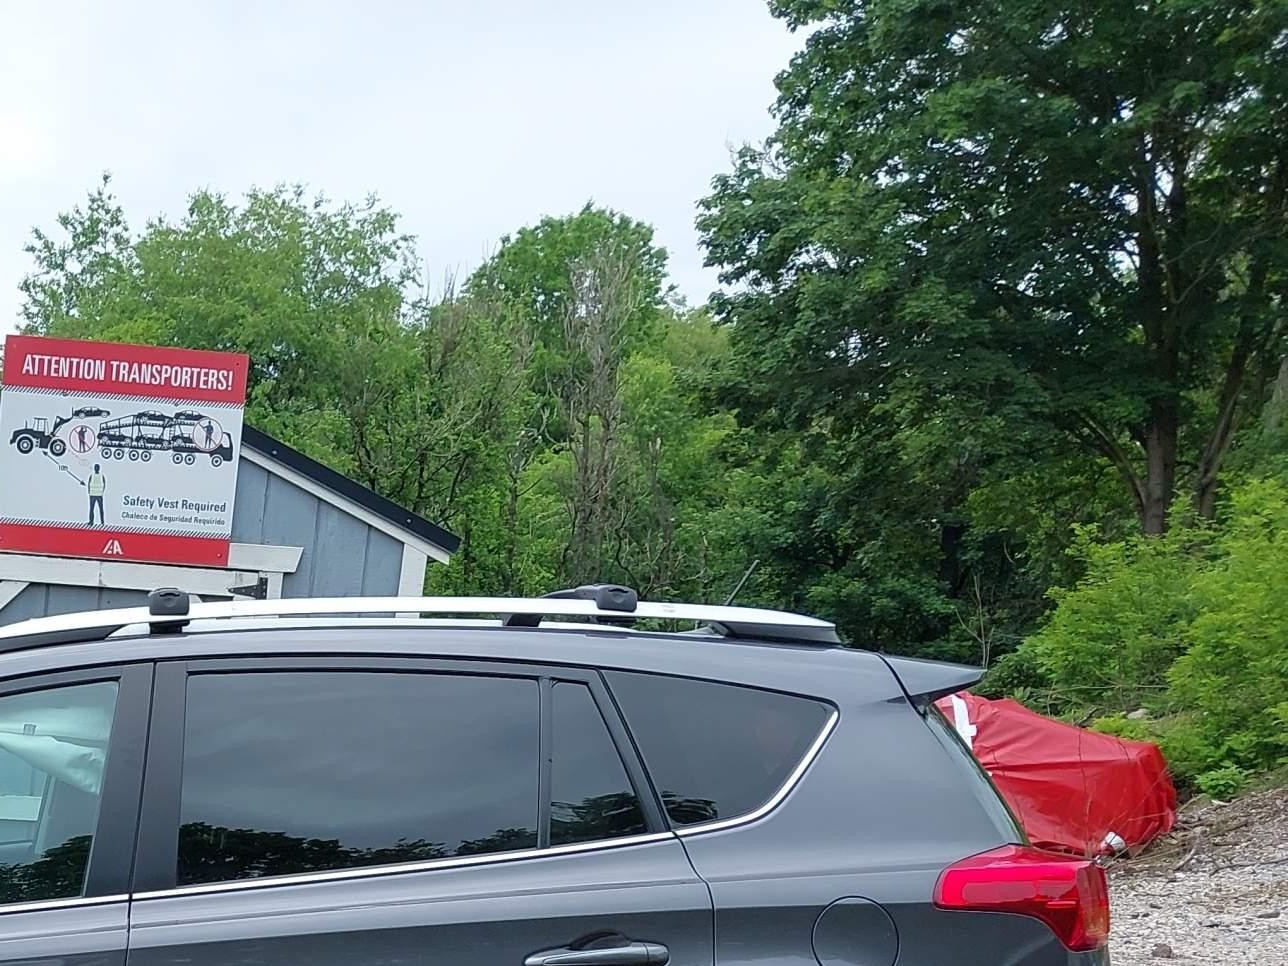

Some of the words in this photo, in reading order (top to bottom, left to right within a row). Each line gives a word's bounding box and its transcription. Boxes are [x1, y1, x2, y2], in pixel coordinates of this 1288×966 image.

[22, 353, 105, 381] ATTENTION
[110, 361, 233, 391] TRANSPORTERS!
[123, 495, 155, 509] Safety
[157, 497, 179, 509] Vest
[181, 499, 227, 513] Required
[121, 511, 149, 520] Chaleco
[149, 513, 158, 521] de
[159, 513, 193, 523] Seguridad
